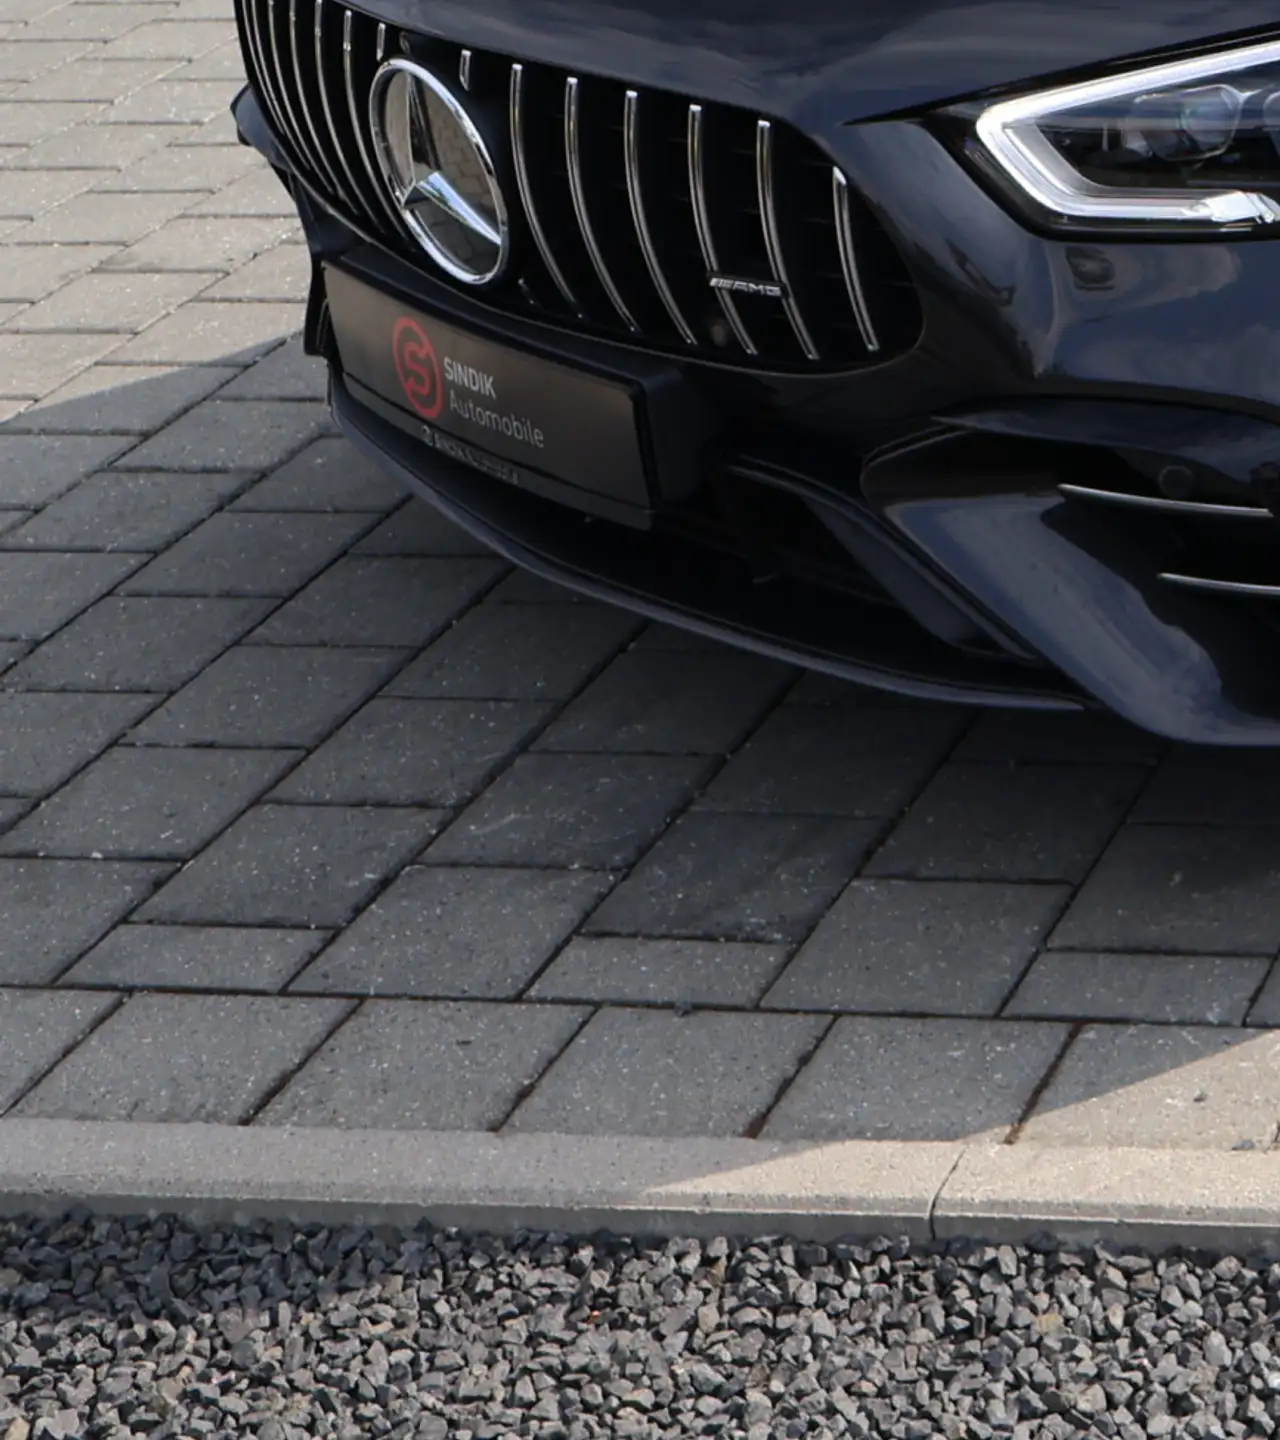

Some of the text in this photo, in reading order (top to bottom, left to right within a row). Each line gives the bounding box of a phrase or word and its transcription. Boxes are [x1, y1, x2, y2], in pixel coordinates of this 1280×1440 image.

[732, 281, 781, 297] AMG
[443, 356, 497, 400] SINDIK
[449, 389, 545, 449] Automobile
